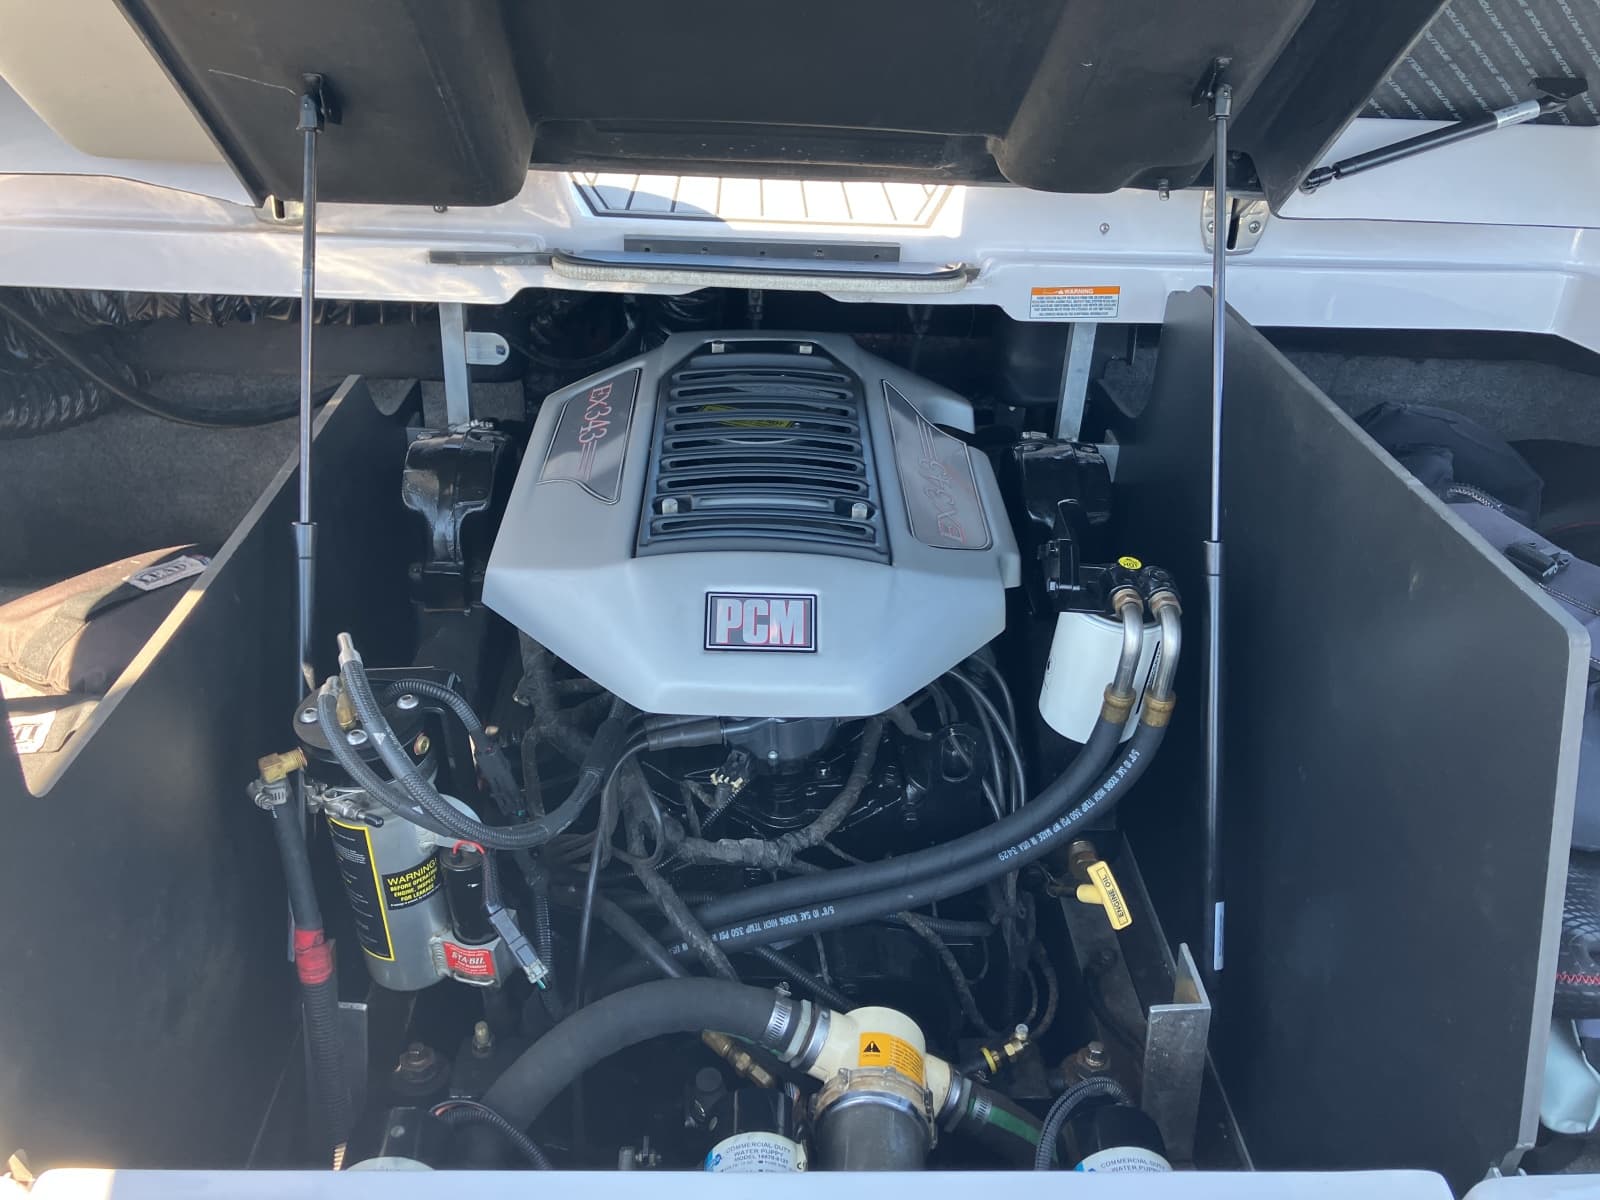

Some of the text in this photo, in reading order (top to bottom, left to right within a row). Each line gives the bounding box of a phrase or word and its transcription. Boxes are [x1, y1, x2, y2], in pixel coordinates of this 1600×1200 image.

[578, 383, 613, 444] EX343
[715, 598, 806, 646] PCM
[1081, 798, 1095, 813] TEMP
[1070, 808, 1082, 821] 350
[1060, 816, 1071, 827] PSI
[1037, 828, 1052, 841] MADE
[1018, 841, 1030, 852] USA
[999, 846, 1017, 862] 3429
[1102, 874, 1124, 918] ENGINE OIL
[800, 911, 811, 920] SAE
[730, 926, 745, 937] 350
[745, 922, 761, 933] TEMP
[718, 930, 730, 941] PSI
[726, 1141, 773, 1154] COMMERCIAL
[734, 1148, 784, 1157] WATER PUPPY
